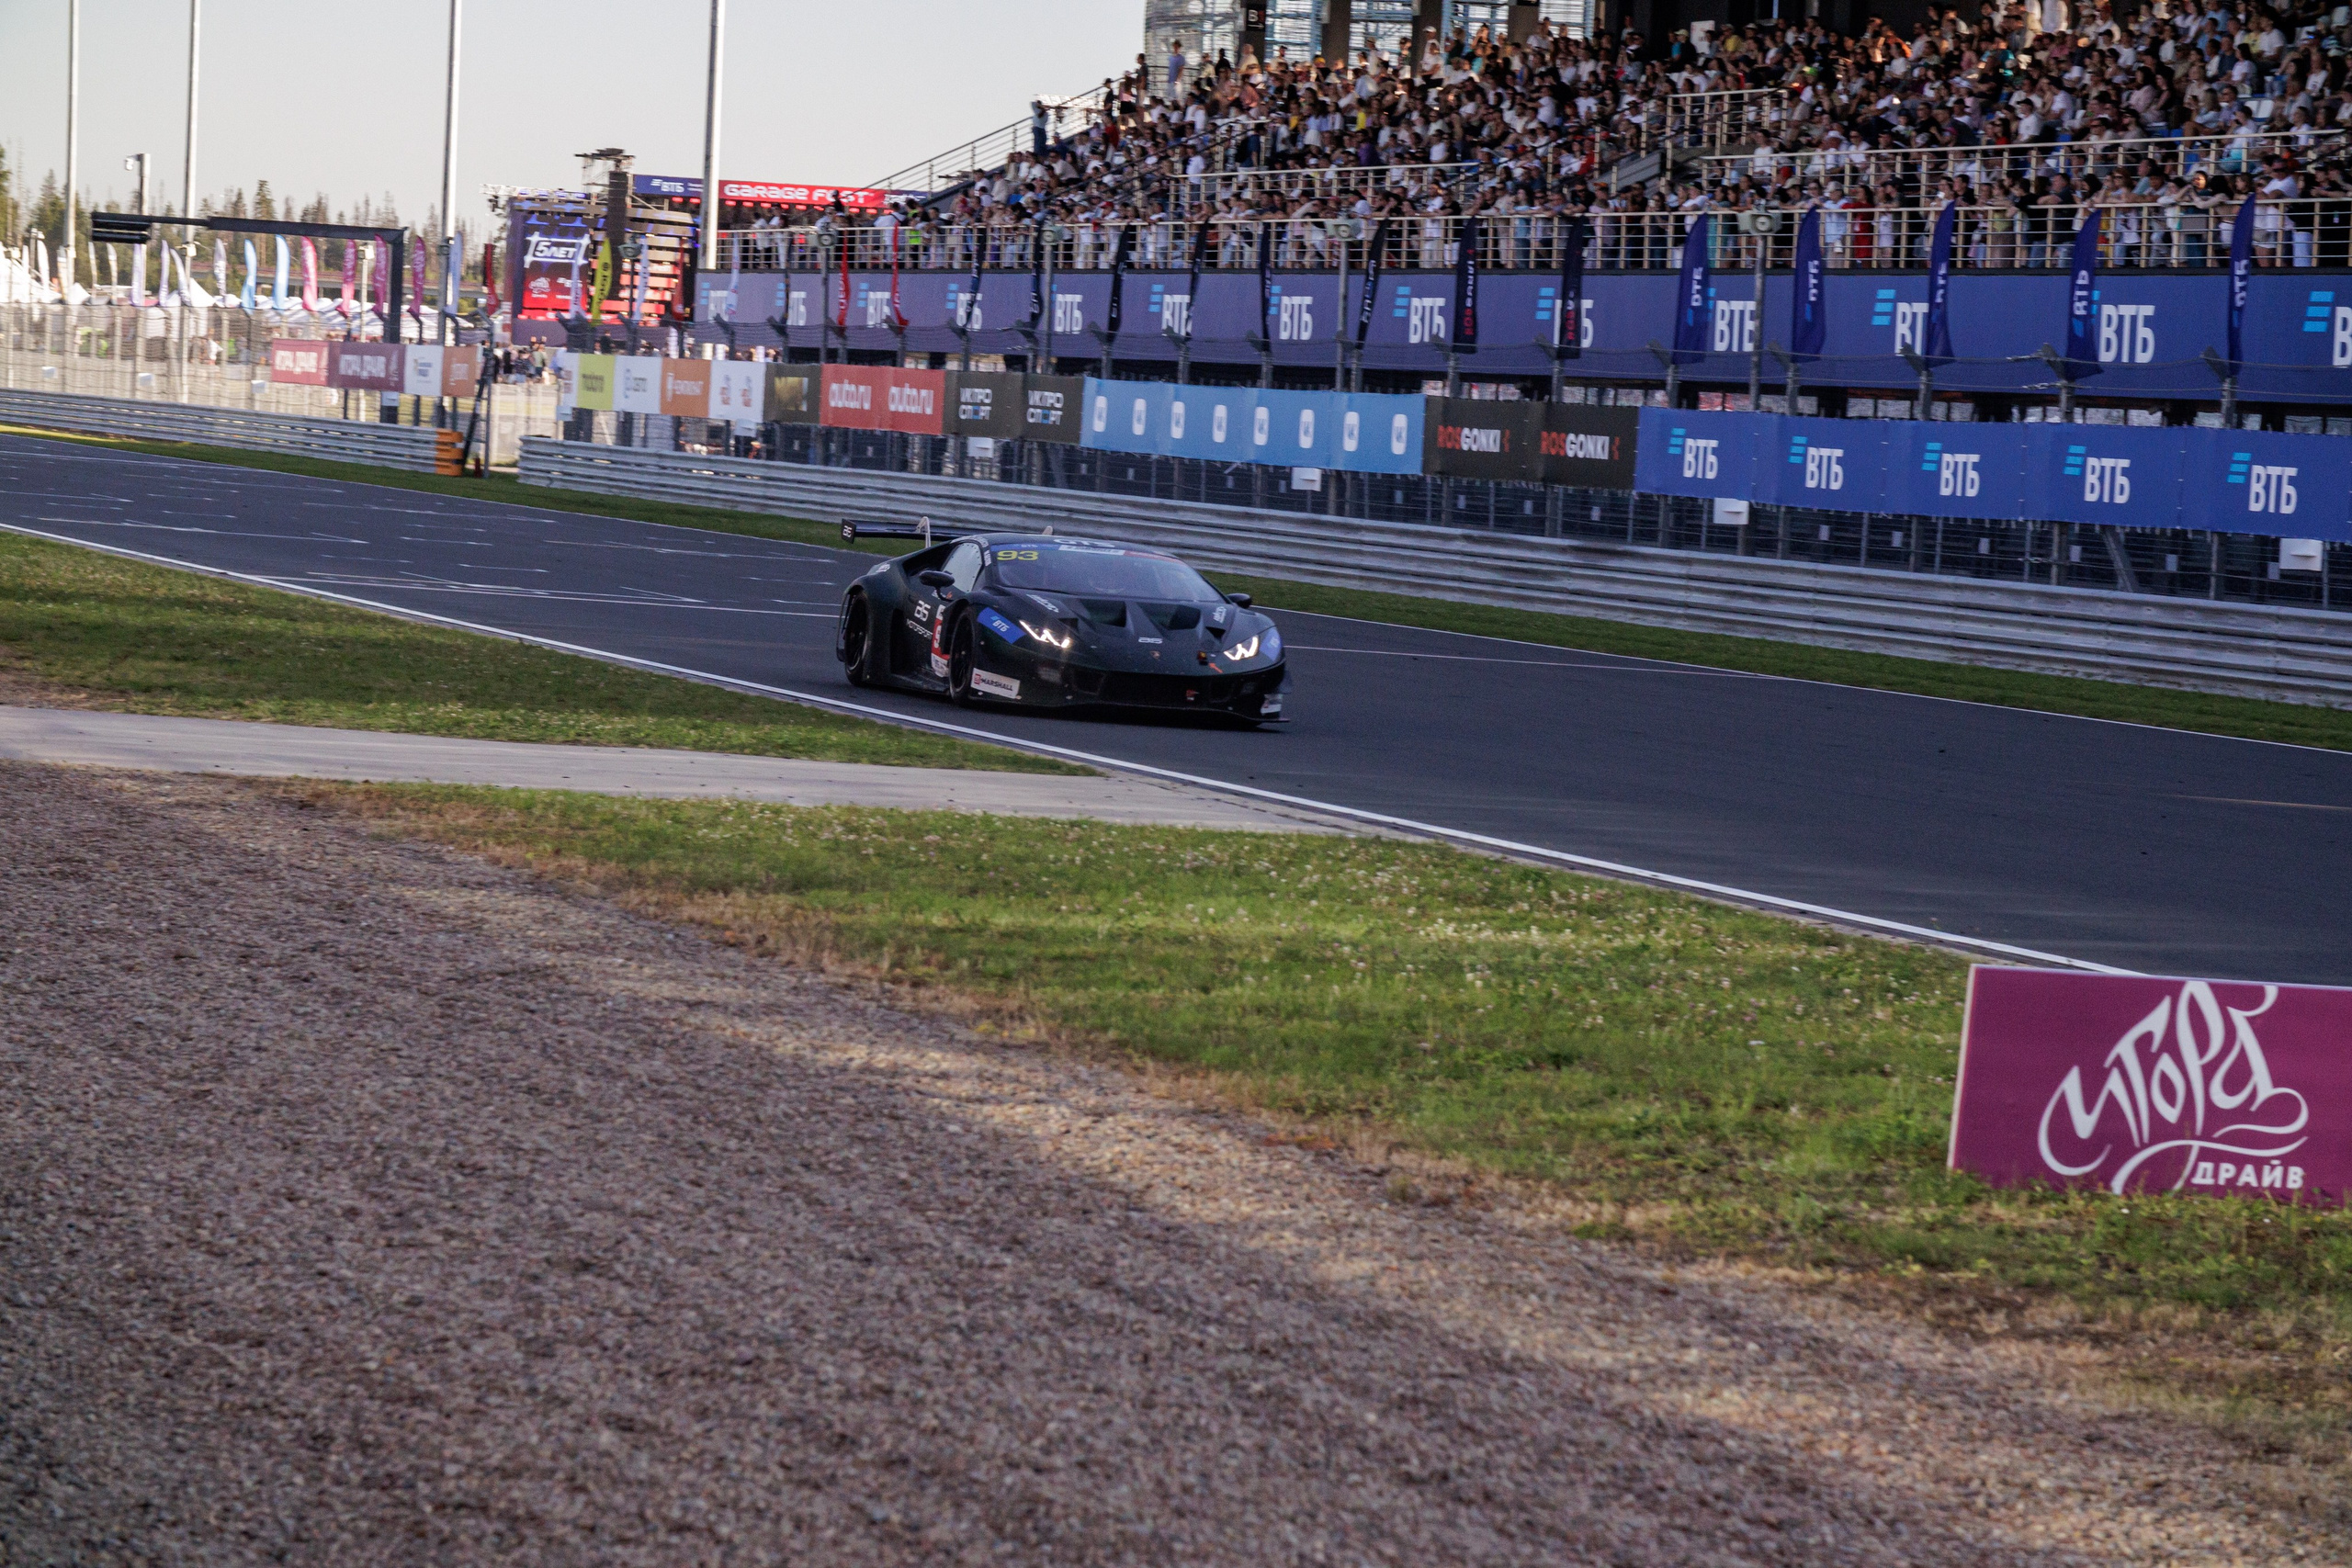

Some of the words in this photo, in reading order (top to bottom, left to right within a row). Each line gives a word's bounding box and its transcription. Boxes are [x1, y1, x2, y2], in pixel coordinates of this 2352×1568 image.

[1054, 293, 1083, 334] ВТБ
[1278, 295, 1314, 340] ВТБ
[1408, 297, 1447, 344] ВТБ
[1894, 301, 1929, 356] ВТ
[2098, 303, 2155, 364] ВТБ
[829, 378, 872, 411] auto.ru
[888, 383, 934, 415] auto.ru
[1437, 425, 1501, 453] ROSGONKI
[1540, 431, 1610, 460] ROSGONKI
[1683, 438, 1719, 479] ВТБ
[1804, 446, 1845, 491] ВТБ
[1939, 453, 1981, 497] ВТБ
[2084, 457, 2132, 504] ВТБ
[2248, 464, 2299, 514] ВТБ
[996, 550, 1039, 561] 93
[992, 619, 1011, 633] ВТБ
[980, 677, 1013, 691] MARSHALL
[2191, 1159, 2306, 1190] ДРАЙВ
